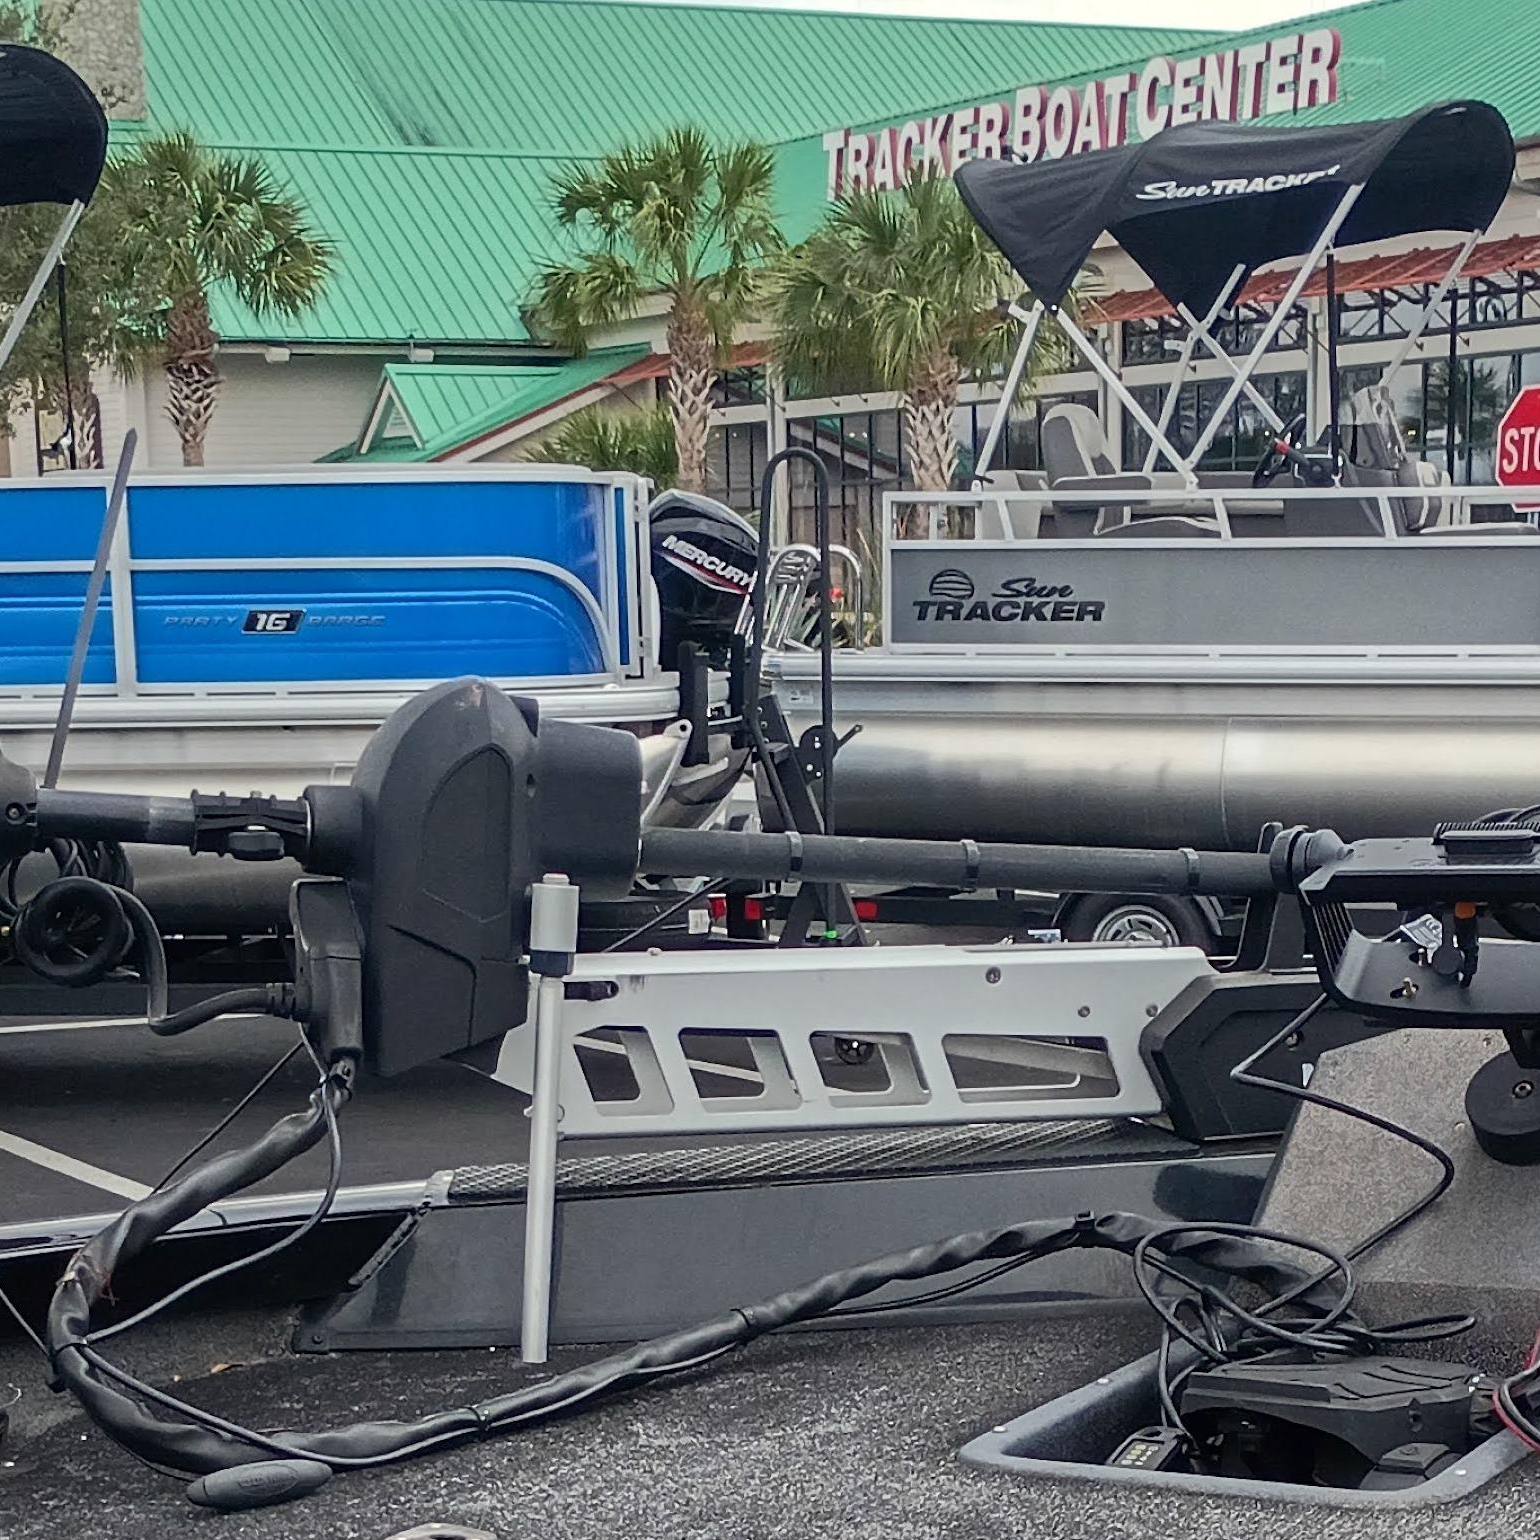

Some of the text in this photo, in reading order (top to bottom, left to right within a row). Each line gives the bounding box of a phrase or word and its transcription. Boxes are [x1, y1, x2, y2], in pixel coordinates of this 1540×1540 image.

[822, 28, 1342, 202] TRACKER BOAT CENTER
[1136, 181, 1211, 200] Sun
[662, 534, 754, 587] MERCURY
[991, 577, 1074, 599] Sun
[913, 600, 1106, 622] TRACKER
[163, 613, 387, 632] PARTY 16 BARGE
